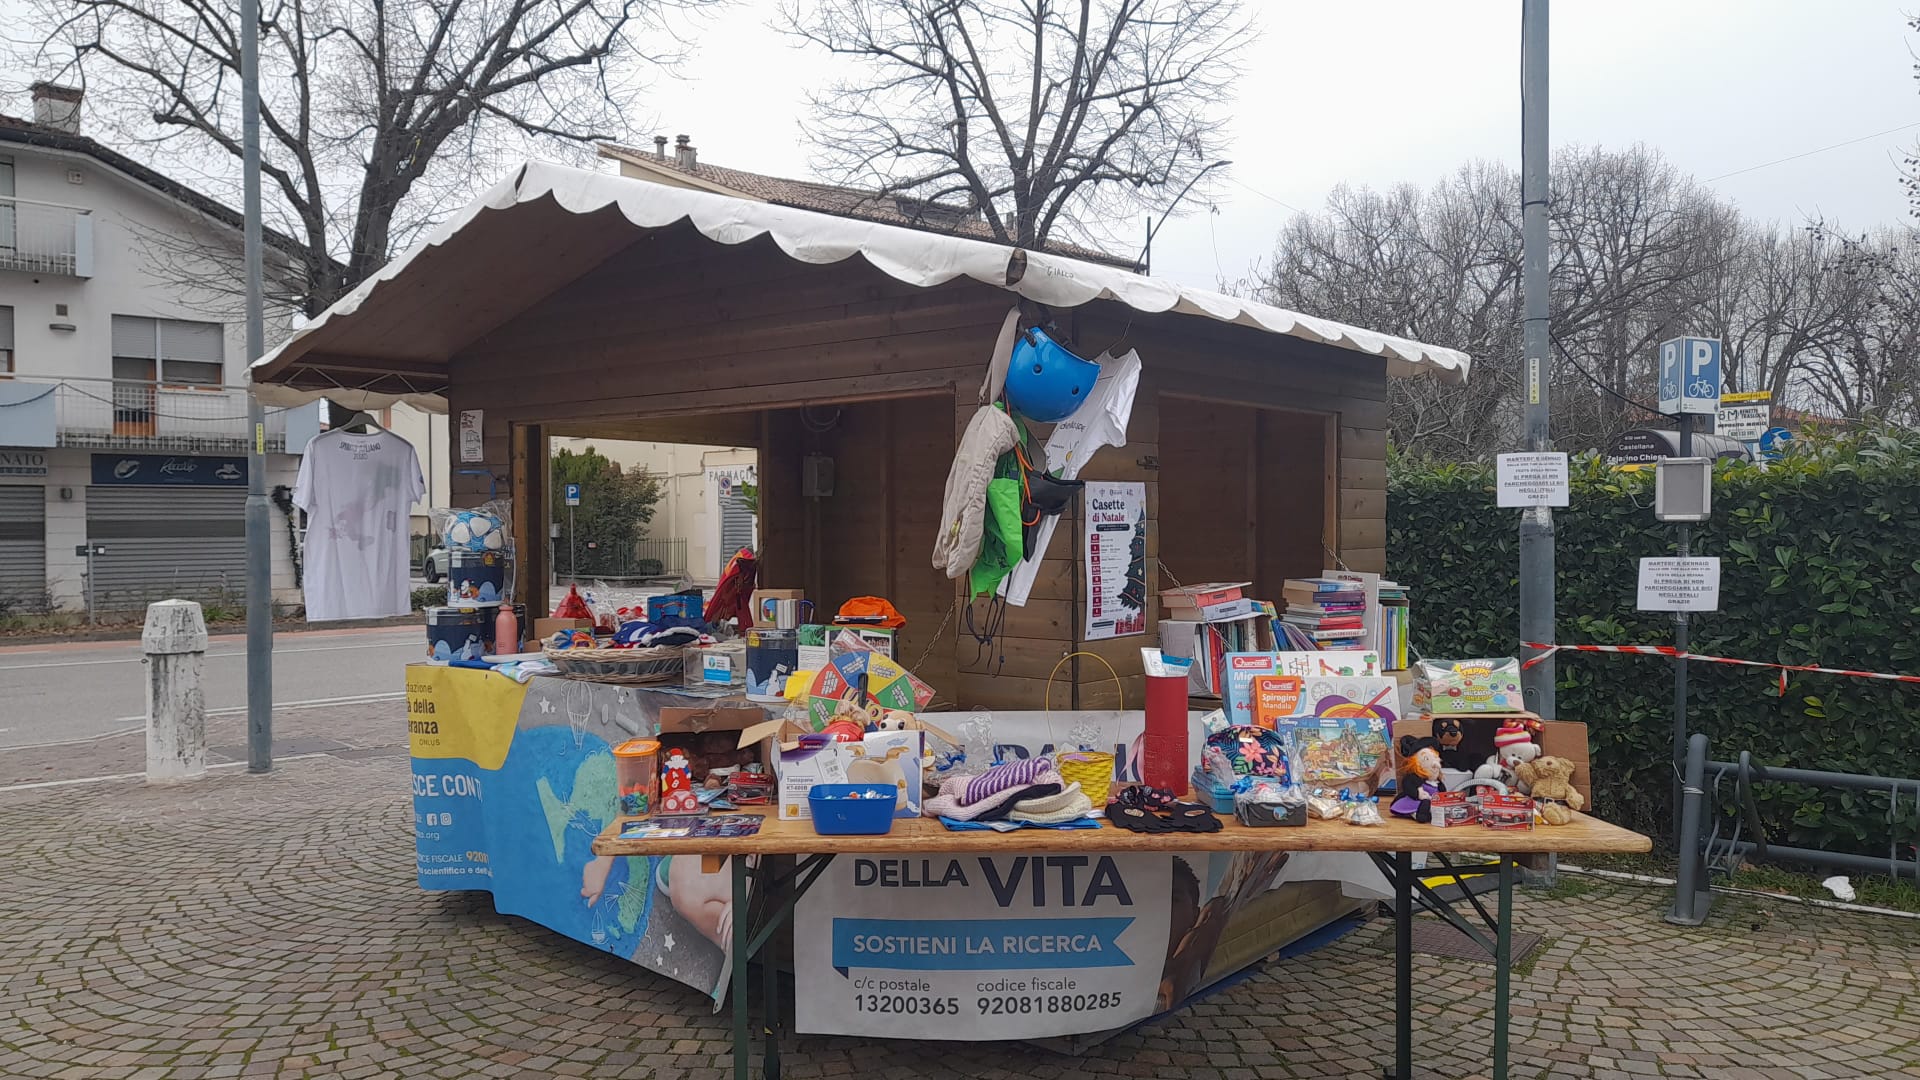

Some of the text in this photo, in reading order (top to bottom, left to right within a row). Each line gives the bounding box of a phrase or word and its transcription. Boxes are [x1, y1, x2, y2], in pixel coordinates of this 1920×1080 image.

[1665, 344, 1676, 379] P
[1692, 341, 1713, 376] P
[1640, 453, 1667, 462] Chiesa
[568, 486, 577, 497] P
[1092, 499, 1125, 510] Casette
[1092, 512, 1125, 522] di Natale
[1262, 693, 1297, 703] Spirogiro
[413, 698, 436, 714] della
[1263, 702, 1292, 710] Mandala
[419, 738, 440, 746] ONLUS
[431, 853, 463, 863] FISCALE
[854, 855, 1134, 908] DELLA VITA
[853, 934, 1103, 955] SOSTIENI LA RICERCA
[854, 975, 1077, 993] c/c postale codice fiscale
[855, 991, 1122, 1016] 13200365 92081880285
